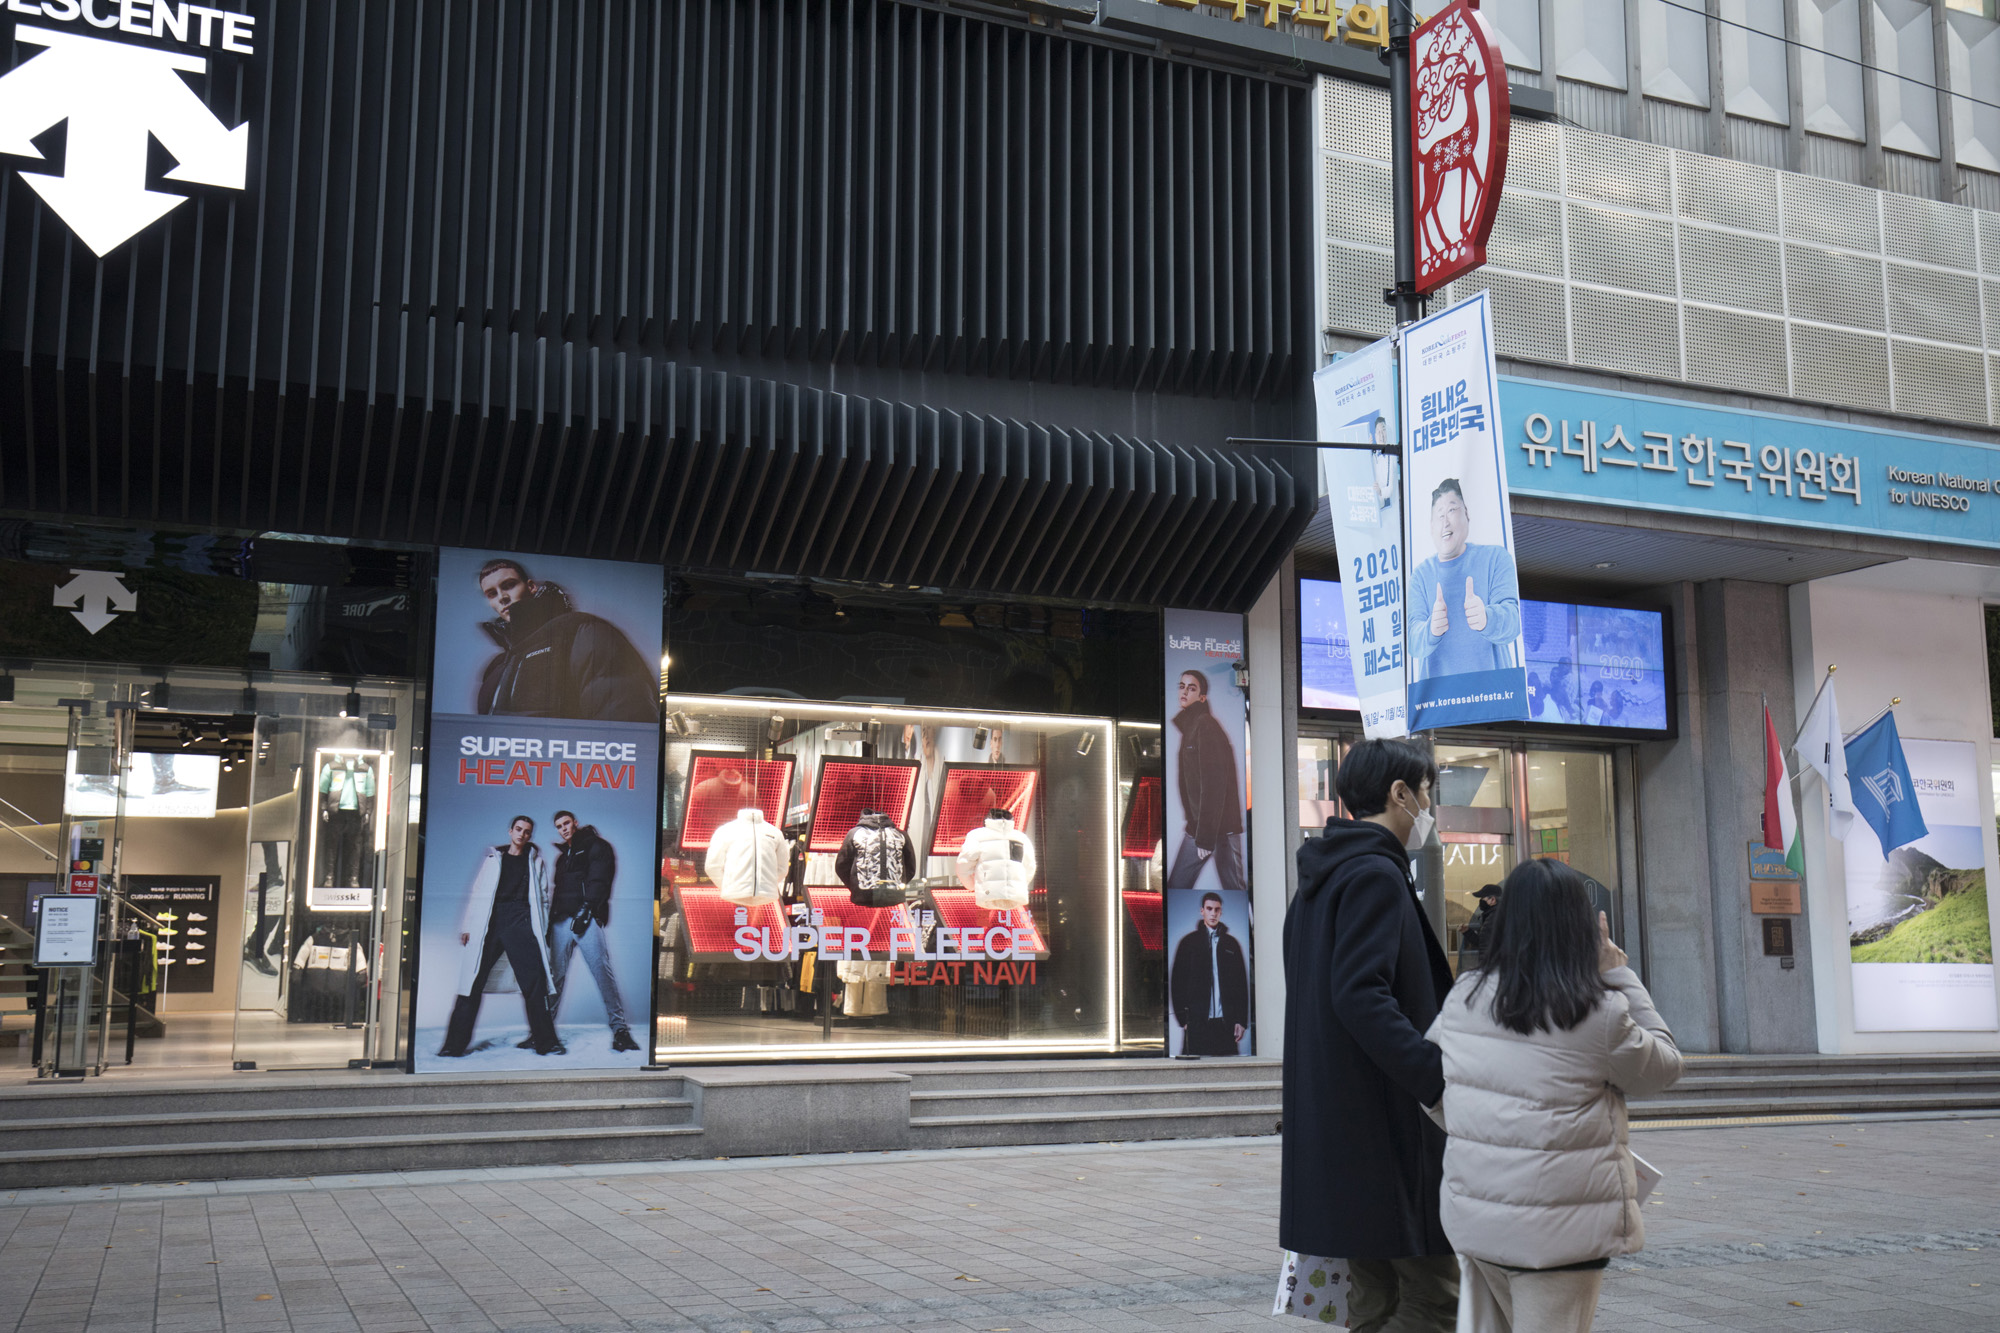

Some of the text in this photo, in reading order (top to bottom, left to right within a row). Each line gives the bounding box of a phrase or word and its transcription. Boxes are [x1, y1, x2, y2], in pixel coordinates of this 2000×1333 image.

[1421, 379, 1468, 422] 힘내요
[1413, 404, 1485, 453] 대한민국
[1521, 412, 1862, 505] 유네스코한국위원회
[1887, 465, 1935, 486] Korean
[1938, 472, 1990, 493] National
[1889, 488, 1970, 512] for UNESCO
[1353, 544, 1399, 583] 2020
[1358, 576, 1400, 614] 코리아
[1169, 640, 1201, 650] SUPER
[1205, 643, 1240, 653] FLEECE
[1600, 654, 1644, 682] 2020
[1415, 690, 1514, 711] www.koreasalefesta.kr
[460, 736, 637, 761] SUPER FLEECE
[458, 758, 635, 790] HEAT NAVI
[733, 907, 748, 926] 올
[795, 907, 824, 926] 겨울
[733, 926, 1036, 961] SUPER FLEECE
[890, 961, 1036, 986] HEAT NAVI
